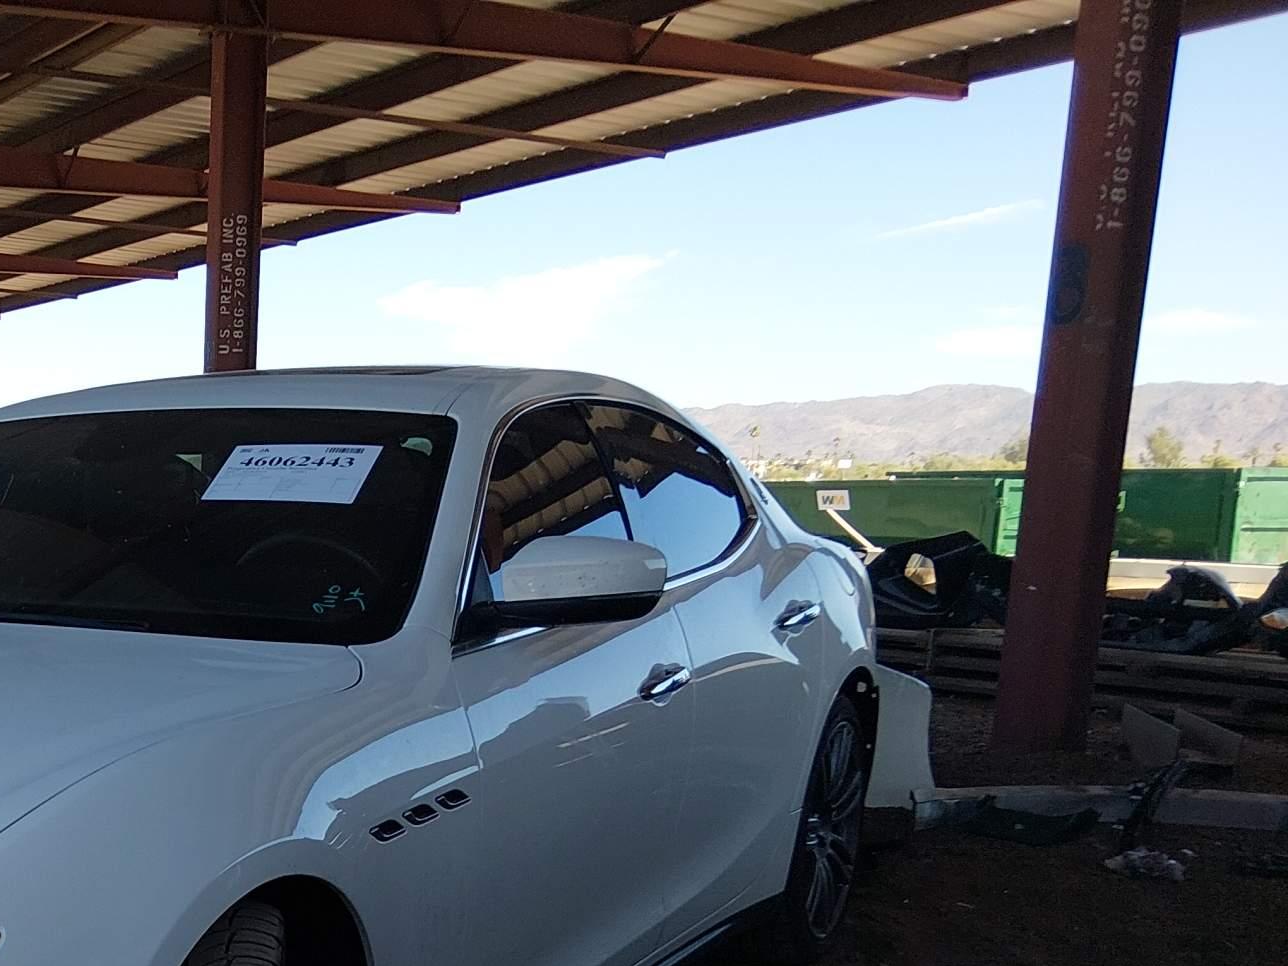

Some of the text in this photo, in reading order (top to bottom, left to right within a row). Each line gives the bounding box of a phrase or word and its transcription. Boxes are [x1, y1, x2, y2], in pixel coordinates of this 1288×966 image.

[218, 213, 235, 354] U.S. PREFAB INC.
[232, 214, 248, 353] 1-866-799-0969
[239, 455, 356, 468] 46062443
